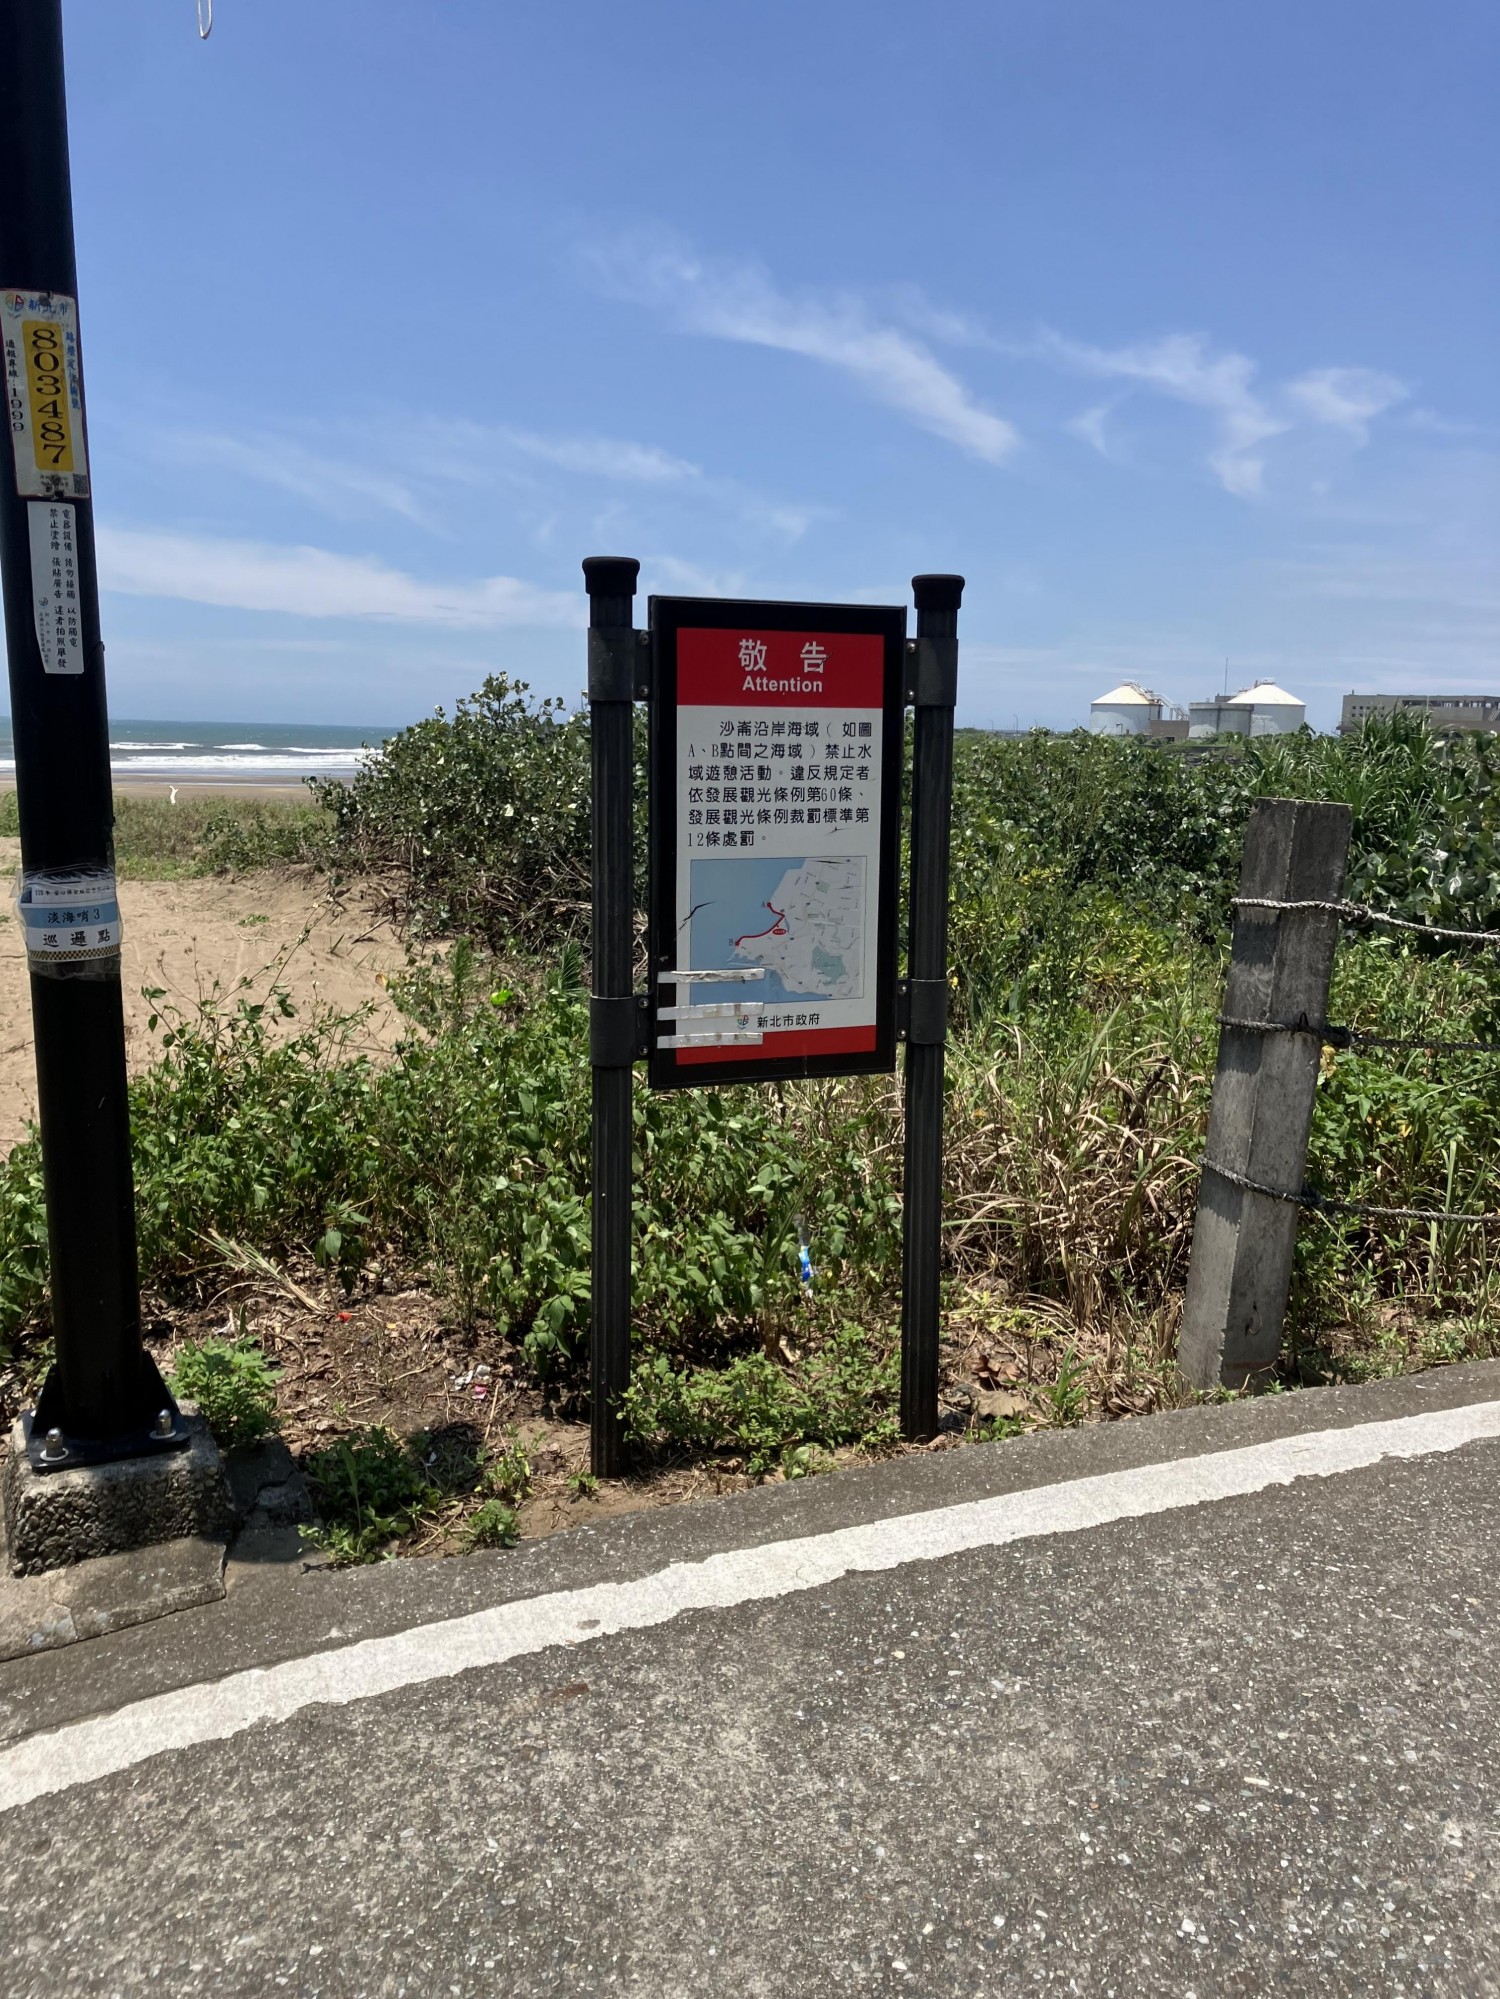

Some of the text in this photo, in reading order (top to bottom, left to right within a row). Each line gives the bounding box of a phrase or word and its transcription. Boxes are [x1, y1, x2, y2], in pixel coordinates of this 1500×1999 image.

[32, 328, 67, 464] 803487
[52, 557, 63, 599] 張貼廣告
[67, 607, 78, 648] 以防觸電
[742, 676, 823, 692] Attention
[688, 765, 870, 781] 域遊憩活動。違反規定者
[688, 808, 870, 825] 發展觀光條例裁罰標準第
[687, 830, 766, 847] 12條處罰。
[43, 928, 111, 947] 巡邏點
[757, 1013, 820, 1028] 新北市政府
